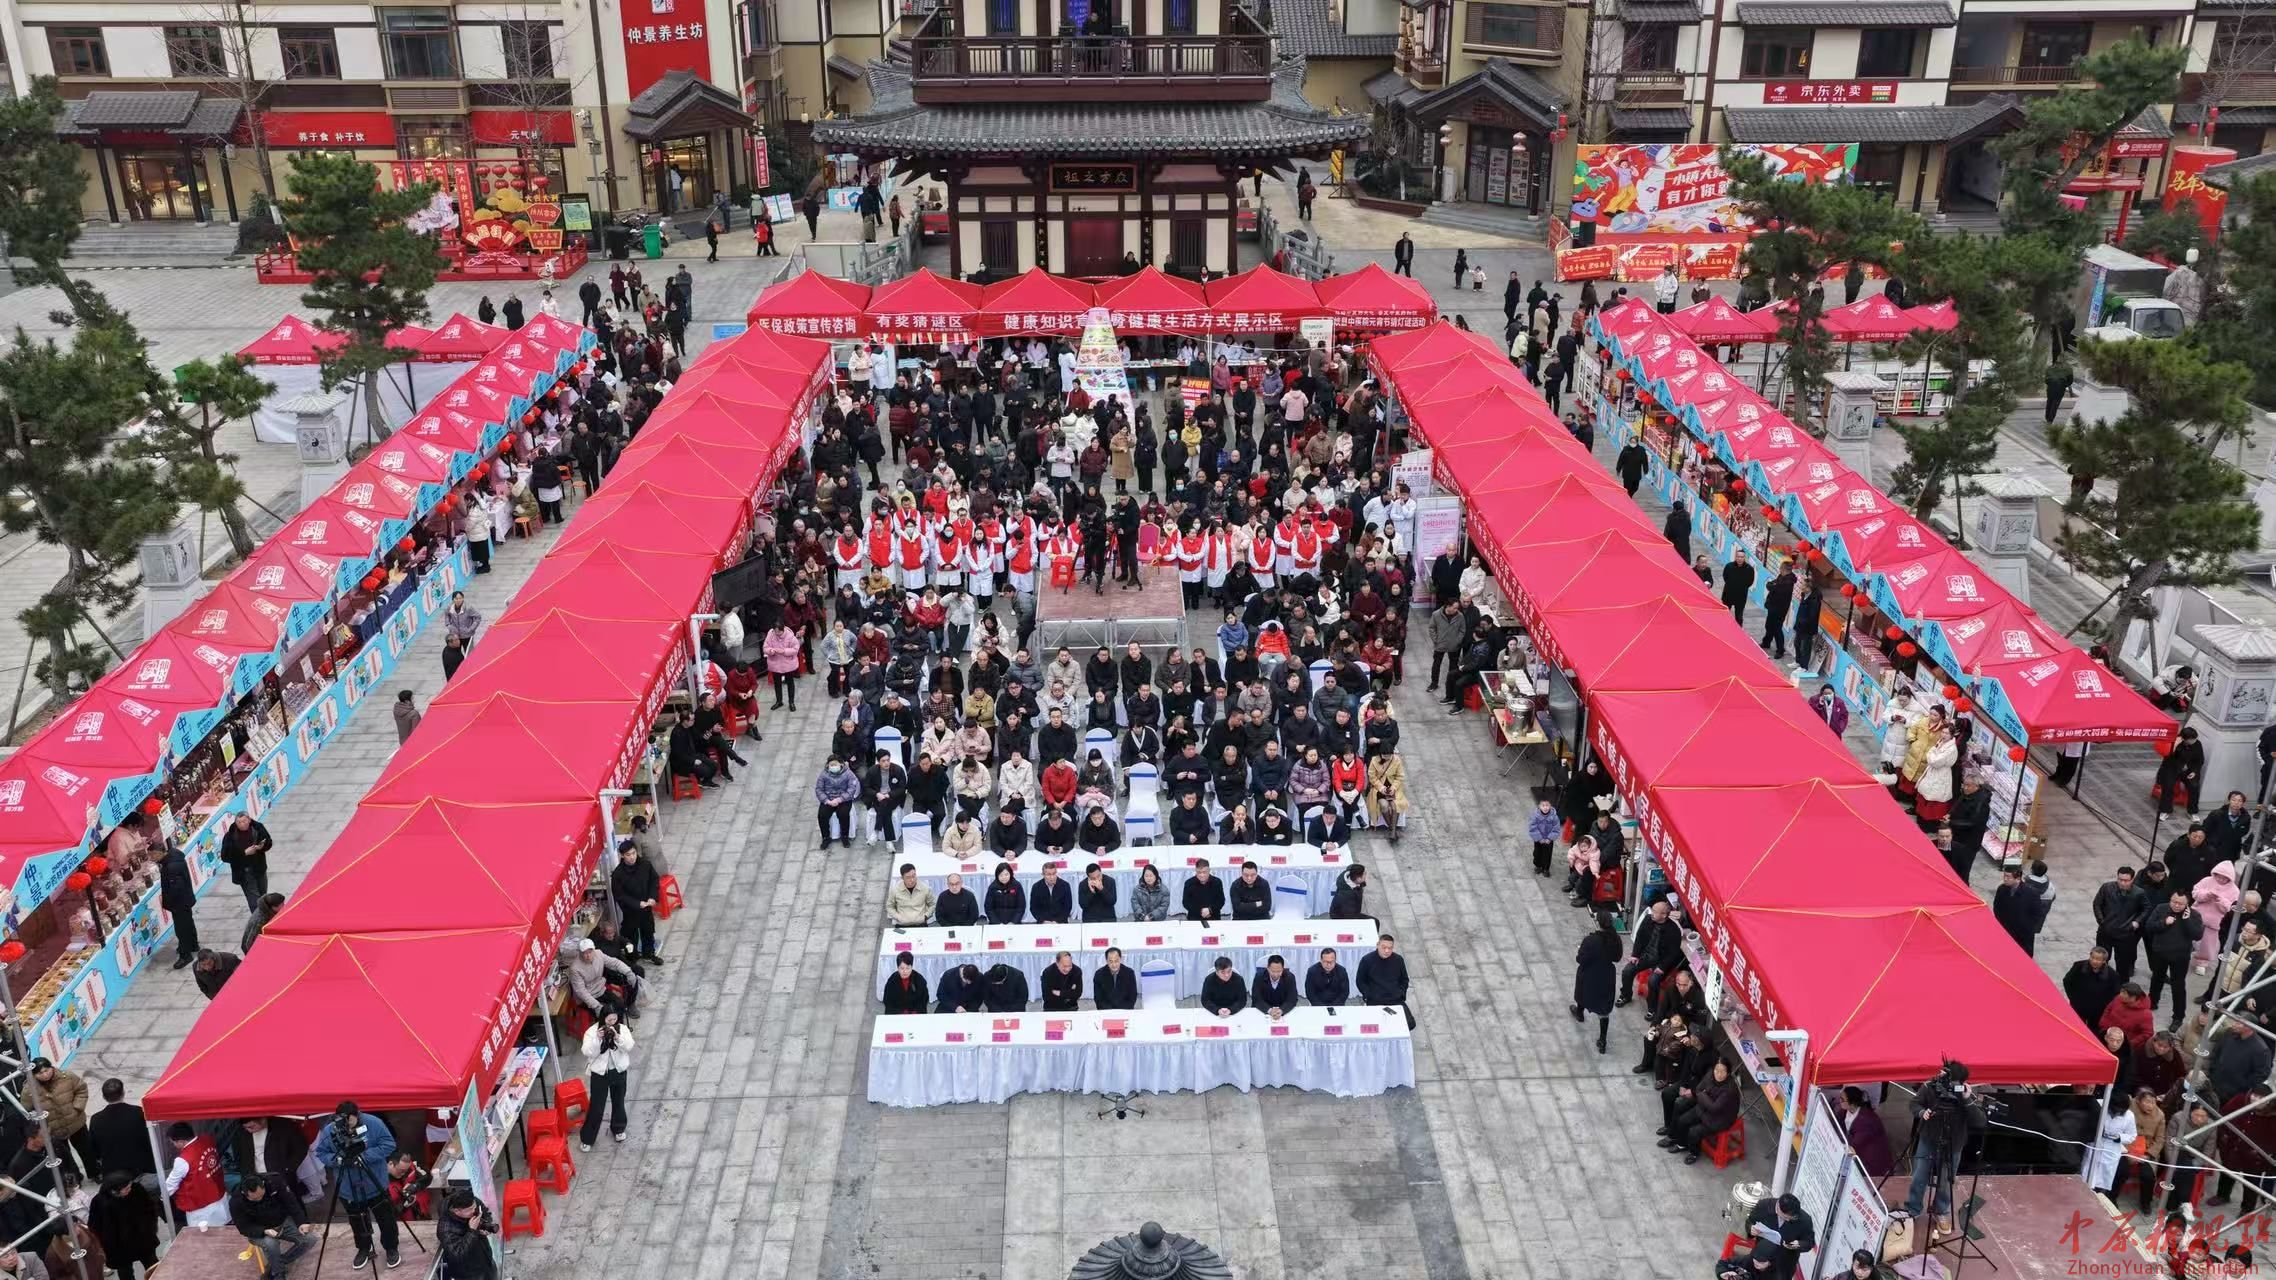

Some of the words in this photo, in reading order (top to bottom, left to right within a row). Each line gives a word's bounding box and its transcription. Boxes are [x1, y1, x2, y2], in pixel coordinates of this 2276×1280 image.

[627, 22, 704, 44] 仲景养生坊
[1800, 84, 1862, 97] 京东外卖
[298, 131, 329, 143] 养于食
[335, 131, 365, 143] 补于饮
[1064, 170, 1129, 184] 众方之祖
[1672, 165, 1730, 187] 小镇大舞
[1665, 182, 1729, 205] 有才你就
[758, 316, 858, 334] 医保政策宣传咨询
[876, 314, 964, 328] 有奖猜谜区
[1003, 311, 1284, 331] 健康知识宣暨健康生活方式展示区
[1332, 316, 1427, 328] 峡县中医院元宵节猜灯谜活动
[239, 657, 252, 692] 中医
[177, 716, 194, 753] 中医
[107, 784, 123, 825] 仲景
[24, 863, 44, 907] 仲景
